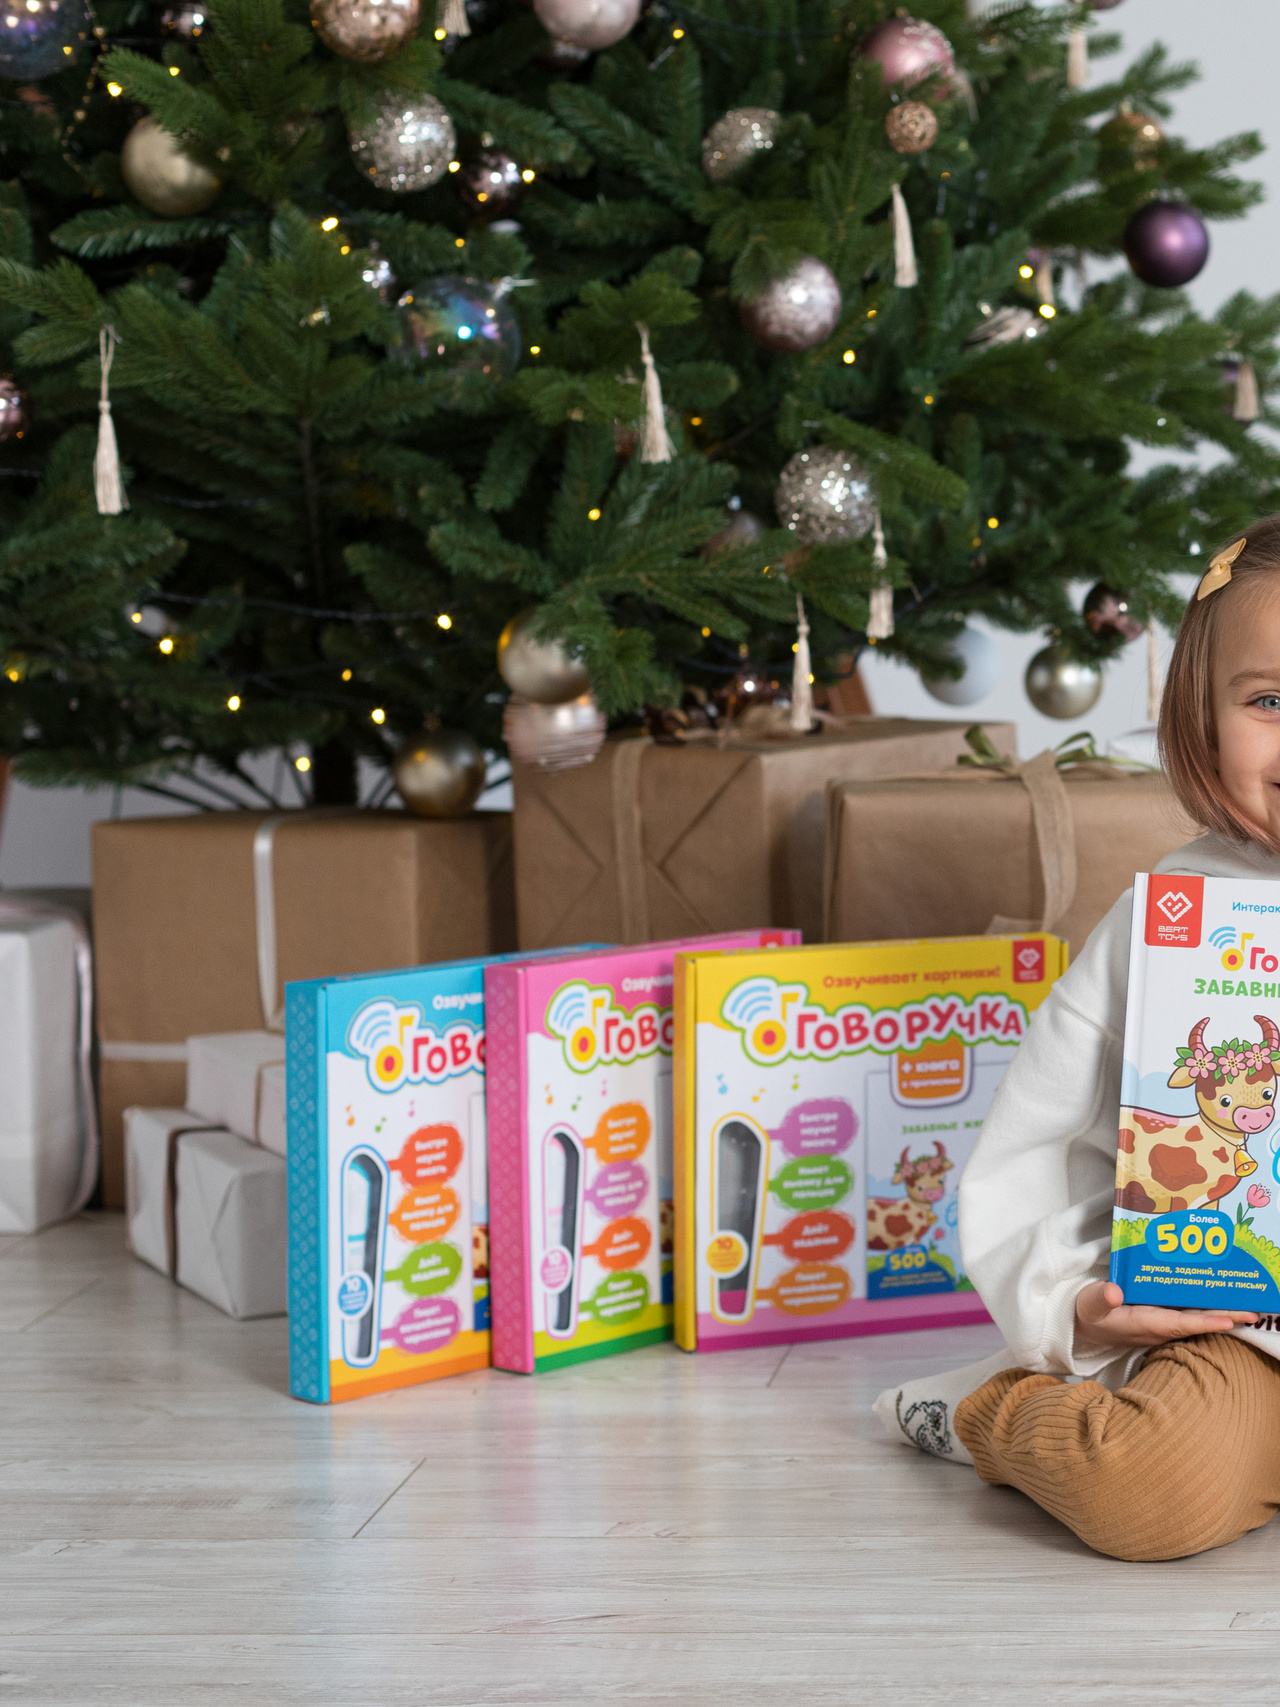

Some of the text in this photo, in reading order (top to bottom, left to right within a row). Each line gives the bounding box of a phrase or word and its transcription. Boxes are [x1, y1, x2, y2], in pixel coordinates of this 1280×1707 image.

[1158, 933, 1188, 941] TOYS
[1189, 1214, 1219, 1224] Более
[1157, 1223, 1228, 1256] 500
[889, 1252, 926, 1271] 500
[1141, 1264, 1259, 1279] звуков, заданий, прописей
[345, 1277, 361, 1292] 10
[1134, 1275, 1152, 1283] для
[1153, 1276, 1203, 1286] подготовки
[1205, 1280, 1226, 1288] руки
[1235, 1282, 1267, 1291] письму
